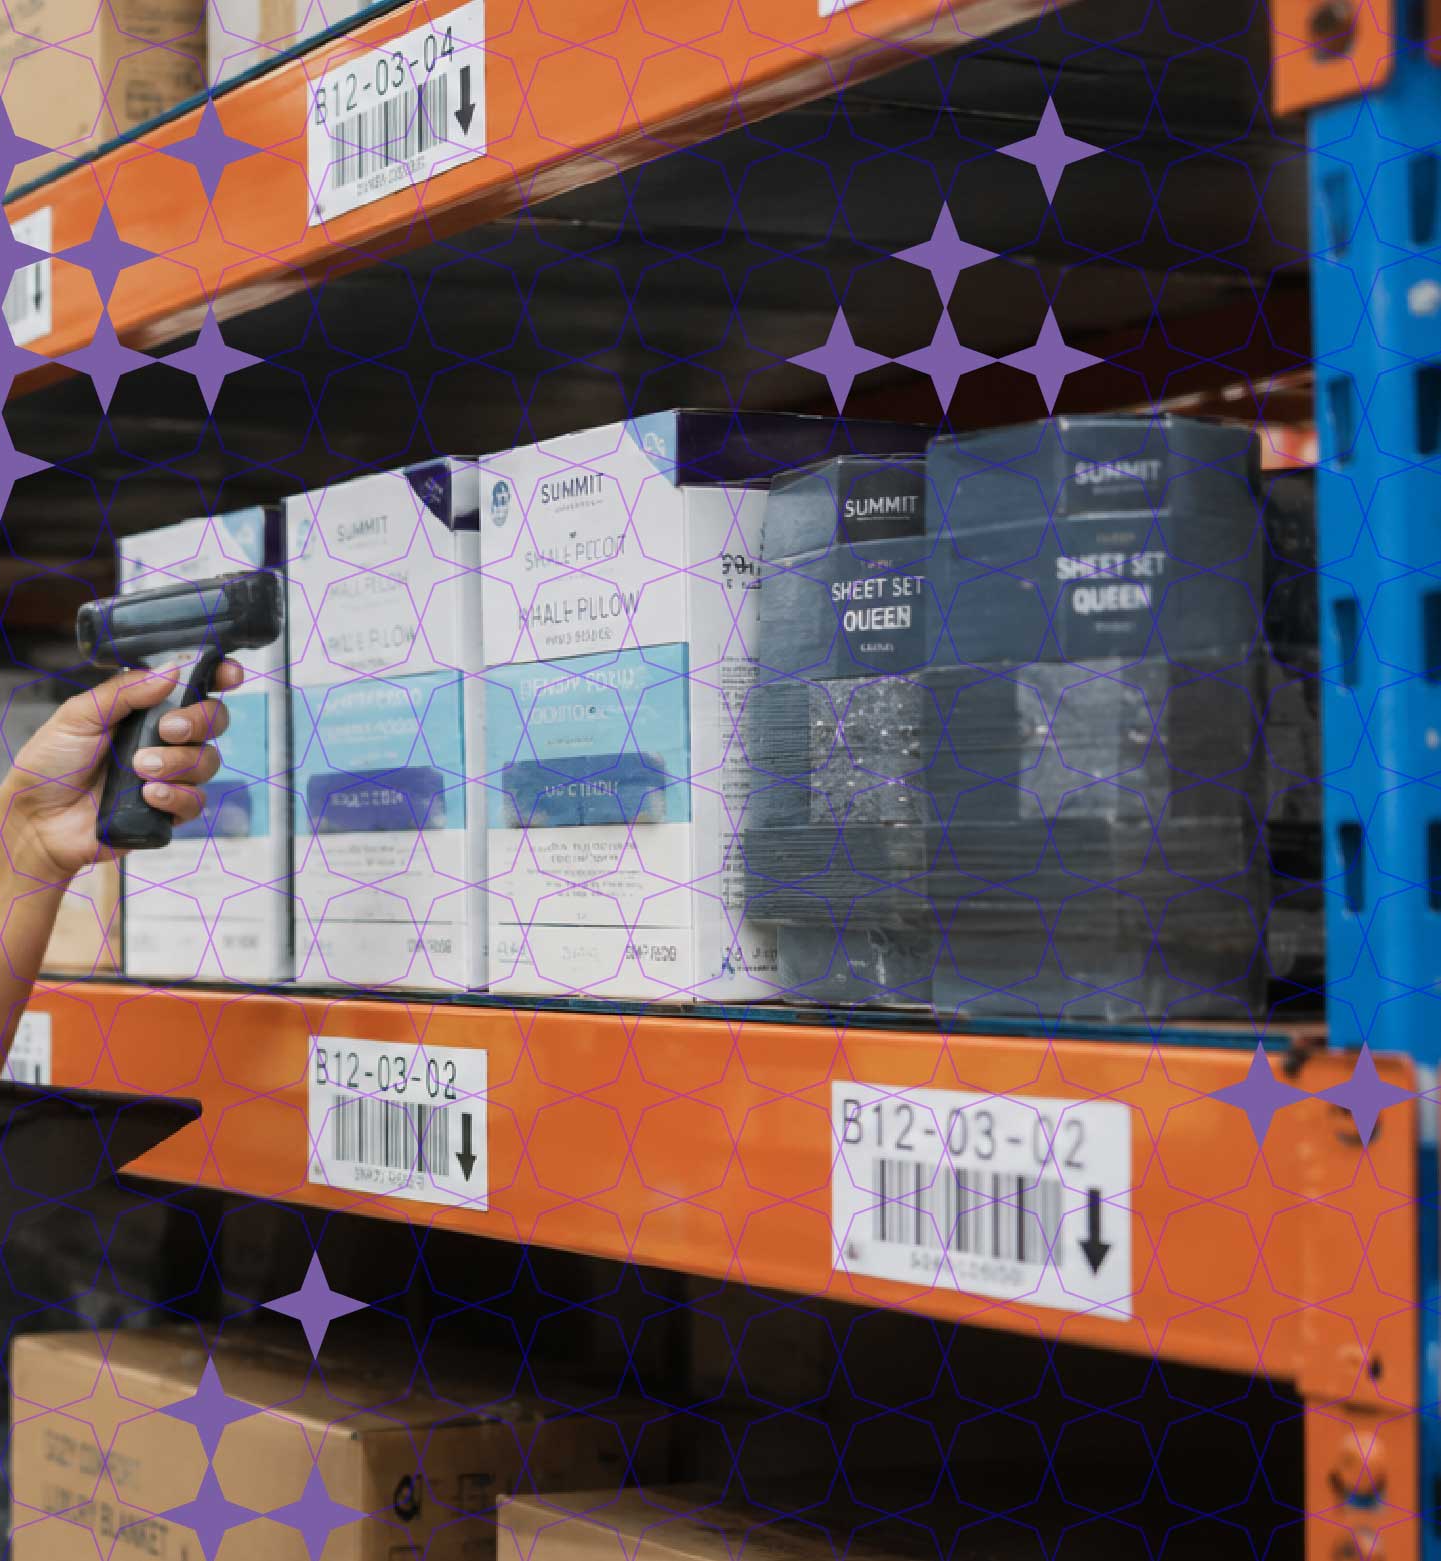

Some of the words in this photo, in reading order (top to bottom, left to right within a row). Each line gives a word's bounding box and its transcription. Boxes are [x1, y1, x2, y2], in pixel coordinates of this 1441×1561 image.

[315, 25, 455, 126] B12-03-04
[1075, 460, 1162, 485] SUMMIT
[541, 472, 604, 504] SUMMIT
[844, 495, 918, 518] SUMMIT
[337, 515, 388, 543] SUMMIT
[1056, 552, 1125, 580] SHEET
[1130, 551, 1167, 577] SET
[832, 577, 887, 602] SHEET
[892, 575, 925, 598] SET
[1072, 583, 1152, 617] QUEEN
[316, 1048, 457, 1100] B12-03-02
[842, 1098, 1085, 1170] B12-03-02
